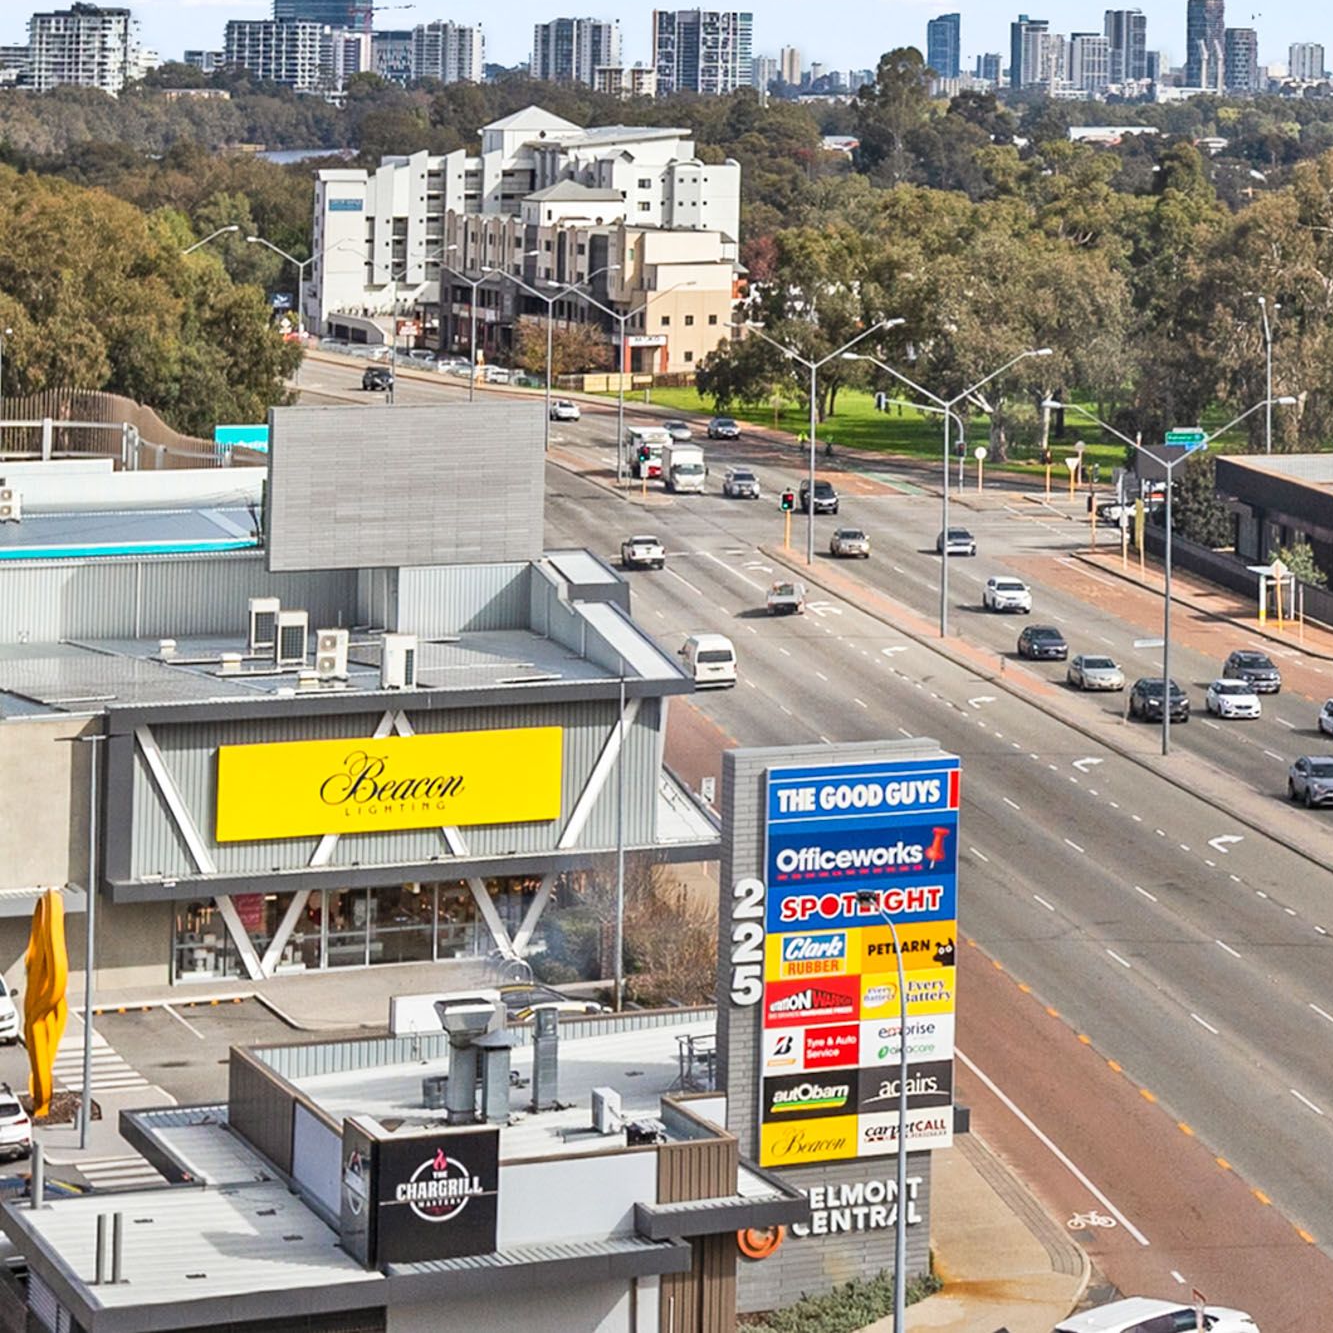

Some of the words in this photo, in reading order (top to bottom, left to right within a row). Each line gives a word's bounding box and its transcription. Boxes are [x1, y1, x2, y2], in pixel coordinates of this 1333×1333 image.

[320, 750, 465, 806] Beacon
[777, 787, 817, 813] THE
[819, 782, 885, 811] GOOD
[885, 779, 942, 807] GUYS
[345, 801, 446, 817] LIGHTING
[776, 841, 923, 873] Officeworks
[784, 936, 843, 961] Clark
[787, 959, 839, 976] RUBBER
[908, 980, 945, 992] Every
[806, 1048, 840, 1059] Service
[807, 1038, 825, 1049] Tyre
[827, 1036, 834, 1046] &
[835, 1034, 857, 1045] Auto
[771, 1127, 846, 1157] Beacon
[432, 1170, 448, 1179] THE
[396, 1176, 483, 1202] CHARGRILL
[799, 1177, 923, 1209] ELMONT
